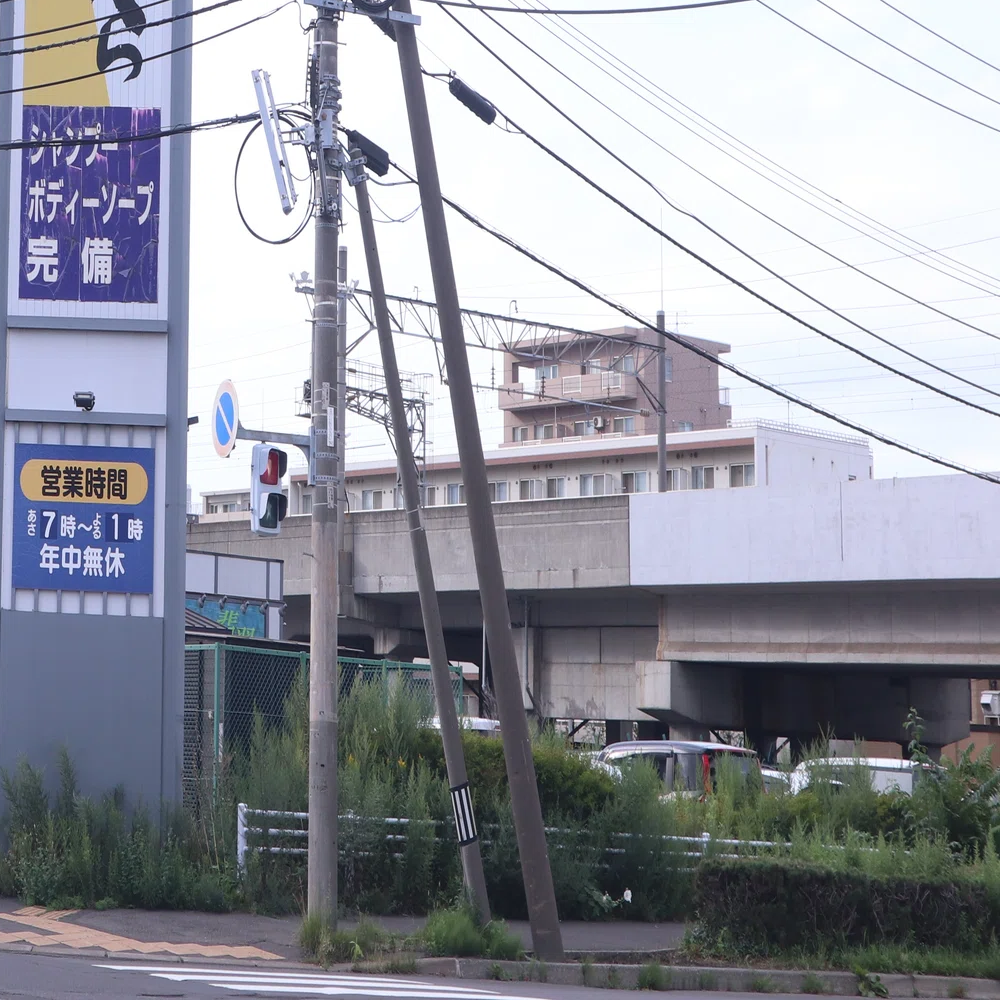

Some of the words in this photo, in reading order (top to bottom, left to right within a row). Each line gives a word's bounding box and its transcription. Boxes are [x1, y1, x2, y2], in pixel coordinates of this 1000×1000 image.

[30, 122, 119, 167] シャンプー
[28, 180, 155, 226] ボディーソープ
[26, 235, 114, 285] 完備
[40, 464, 128, 501] 営業時間
[39, 542, 126, 579] 年中無休
